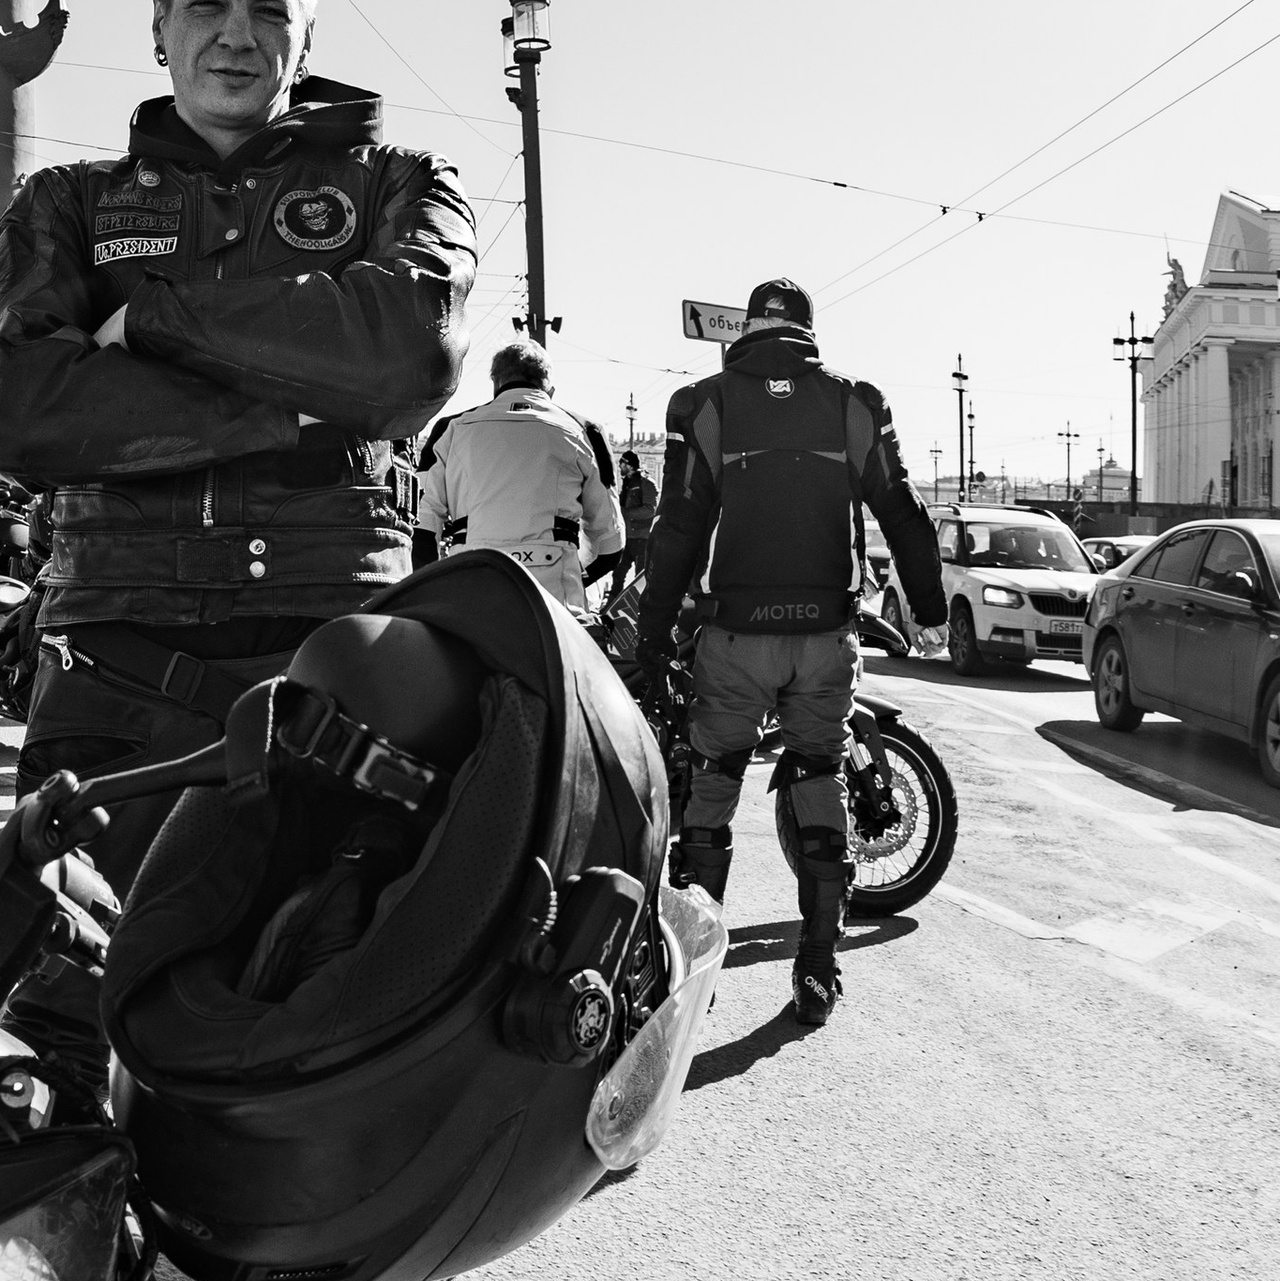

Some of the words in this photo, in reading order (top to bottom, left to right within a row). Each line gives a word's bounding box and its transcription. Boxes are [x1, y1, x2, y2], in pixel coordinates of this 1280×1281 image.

[280, 191, 317, 206] SUPPORT
[317, 187, 340, 196] CLUB
[749, 603, 820, 622] MOTEQ
